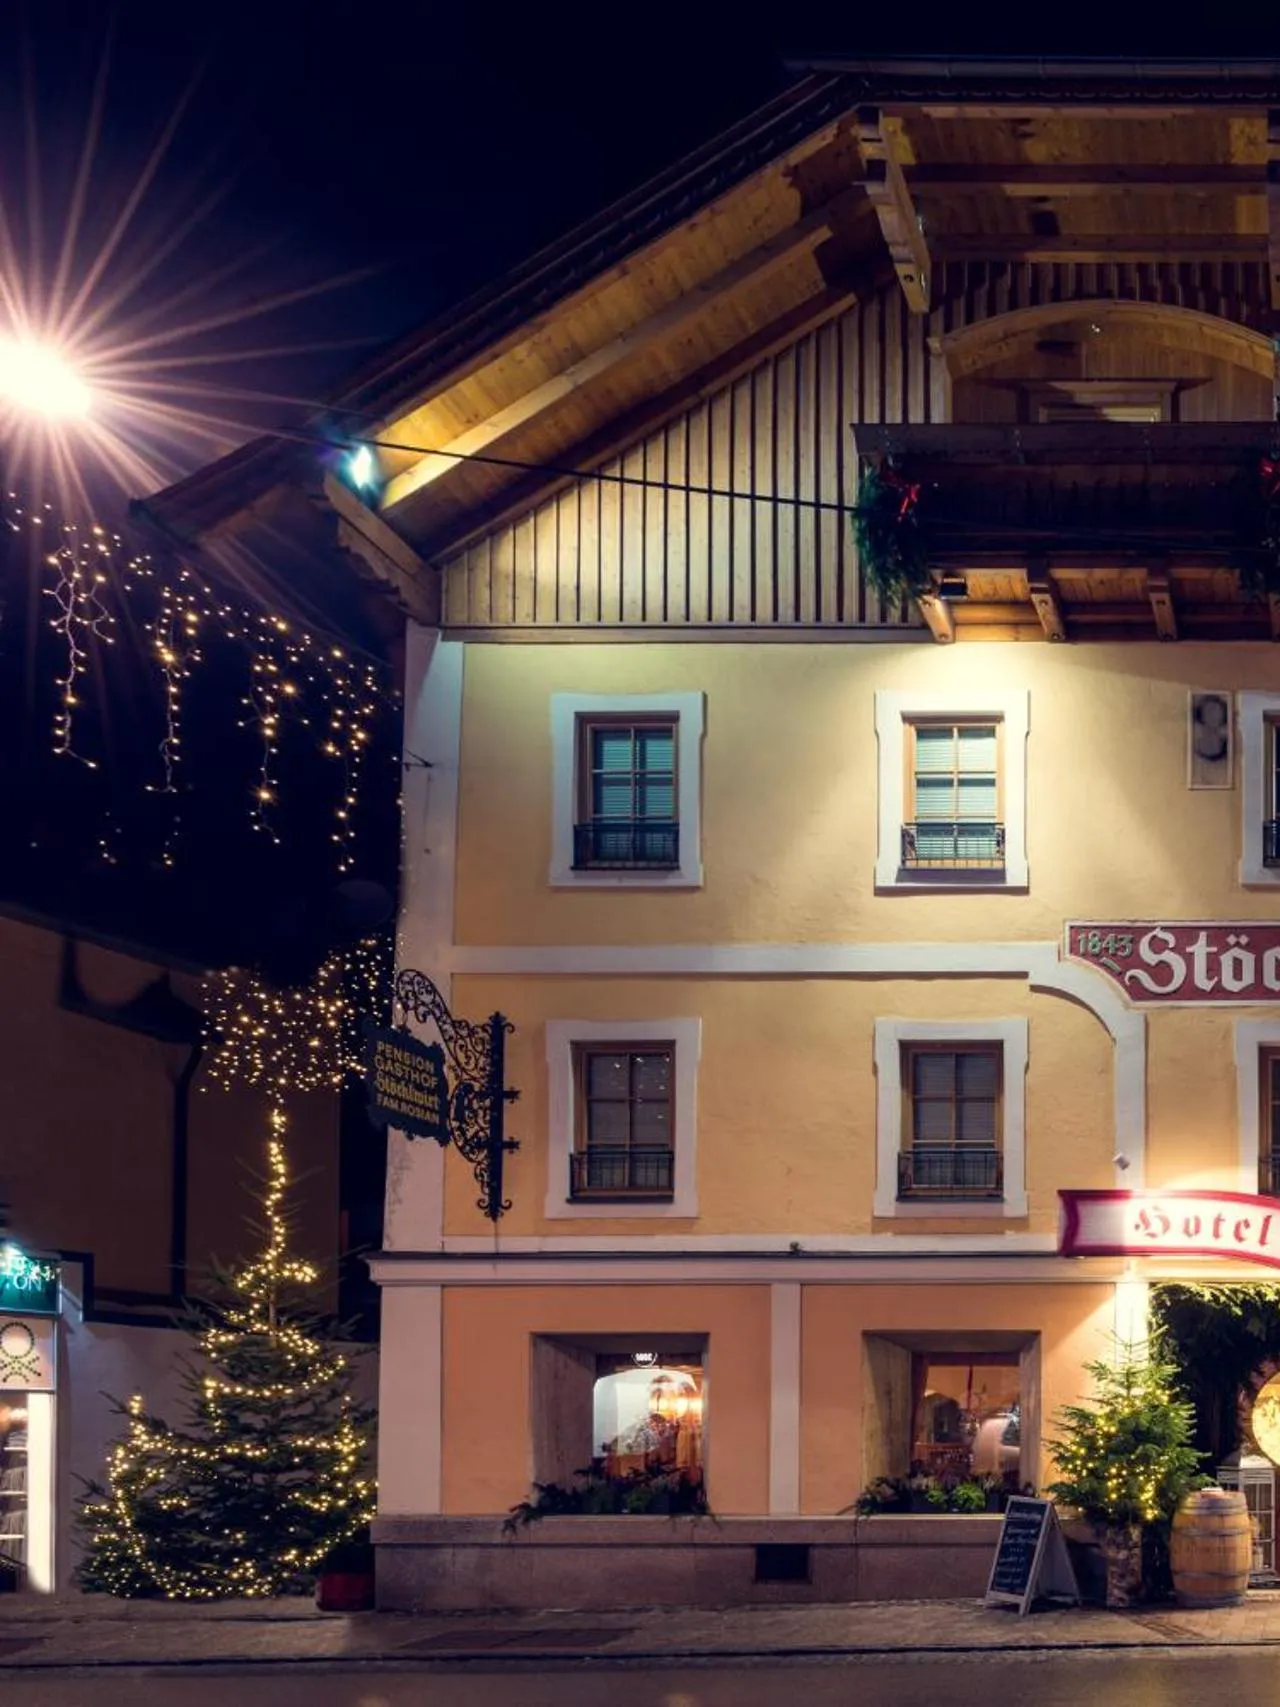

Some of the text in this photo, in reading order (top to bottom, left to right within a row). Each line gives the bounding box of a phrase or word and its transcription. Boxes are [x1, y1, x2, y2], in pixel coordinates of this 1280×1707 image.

[1077, 929, 1133, 956] 1843
[374, 1054, 439, 1089] GASTHOF
[376, 1040, 435, 1074] PENSION
[1134, 1205, 1273, 1247] Hotel
